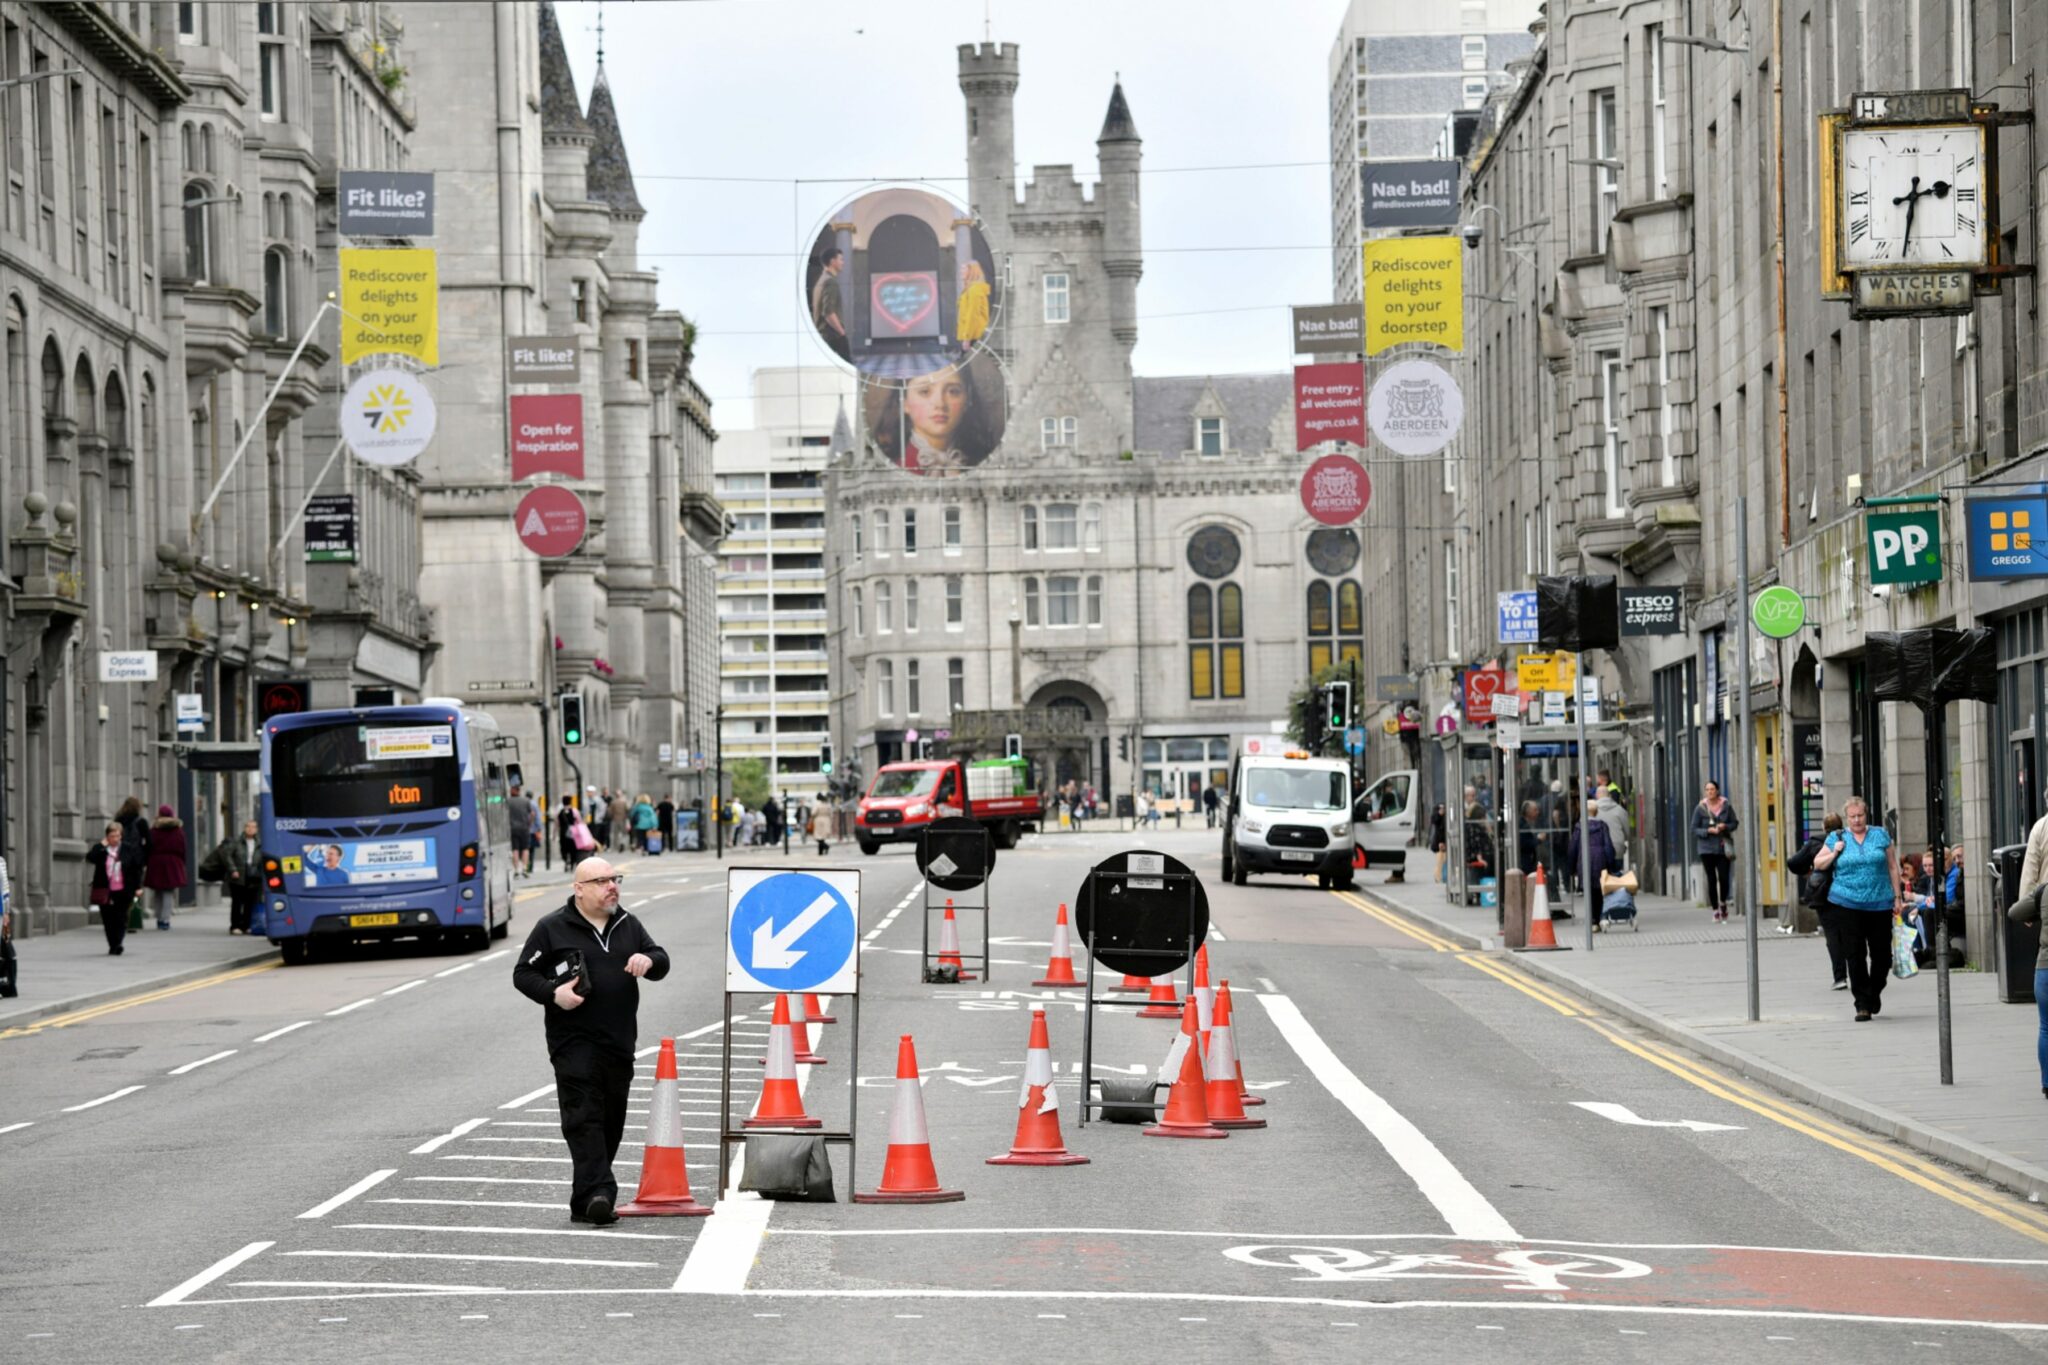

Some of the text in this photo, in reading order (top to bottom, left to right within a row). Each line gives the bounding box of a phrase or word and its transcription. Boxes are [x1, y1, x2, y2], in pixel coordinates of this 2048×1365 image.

[1884, 94, 1966, 117] SAMUEL
[1372, 179, 1450, 198] Nae bad!
[347, 188, 426, 208] Fit like?
[1372, 199, 1451, 210] #RediscoverABDN
[1372, 259, 1453, 273] Rediscover
[348, 268, 429, 283] Rediscover
[1869, 275, 1961, 291] WATCHES
[1383, 278, 1442, 296] delights
[360, 289, 418, 307] delights
[1886, 290, 1945, 305] RINGS
[1385, 300, 1442, 317] on your
[361, 312, 417, 328] on your
[1299, 317, 1359, 333] Nae bad!
[1380, 319, 1448, 335] doorstep
[356, 330, 424, 347] doorstep
[513, 348, 575, 363] Fit like?
[1301, 385, 1324, 396] Free
[1326, 384, 1354, 397] entry
[1301, 396, 1362, 410] all welcome!
[520, 423, 574, 439] Open for
[1304, 416, 1360, 431] aagm.co.uk
[1383, 419, 1449, 431] ABERDEEN
[1409, 430, 1441, 438] COUNCIL
[355, 436, 426, 449] visitabdn.com
[516, 440, 580, 455] inspiration
[1311, 497, 1362, 508] ABERDEEN
[310, 540, 327, 551] FOR
[327, 540, 347, 550] SALE
[1991, 555, 2032, 566] GREGGS
[1624, 595, 1675, 608] TESCO
[1503, 605, 1522, 619] TO
[1760, 600, 1800, 619] VPZ
[1625, 612, 1675, 627] express
[110, 656, 145, 667] Optical
[108, 668, 147, 678] Express
[1529, 668, 1545, 676] Off
[275, 819, 308, 831] 63202
